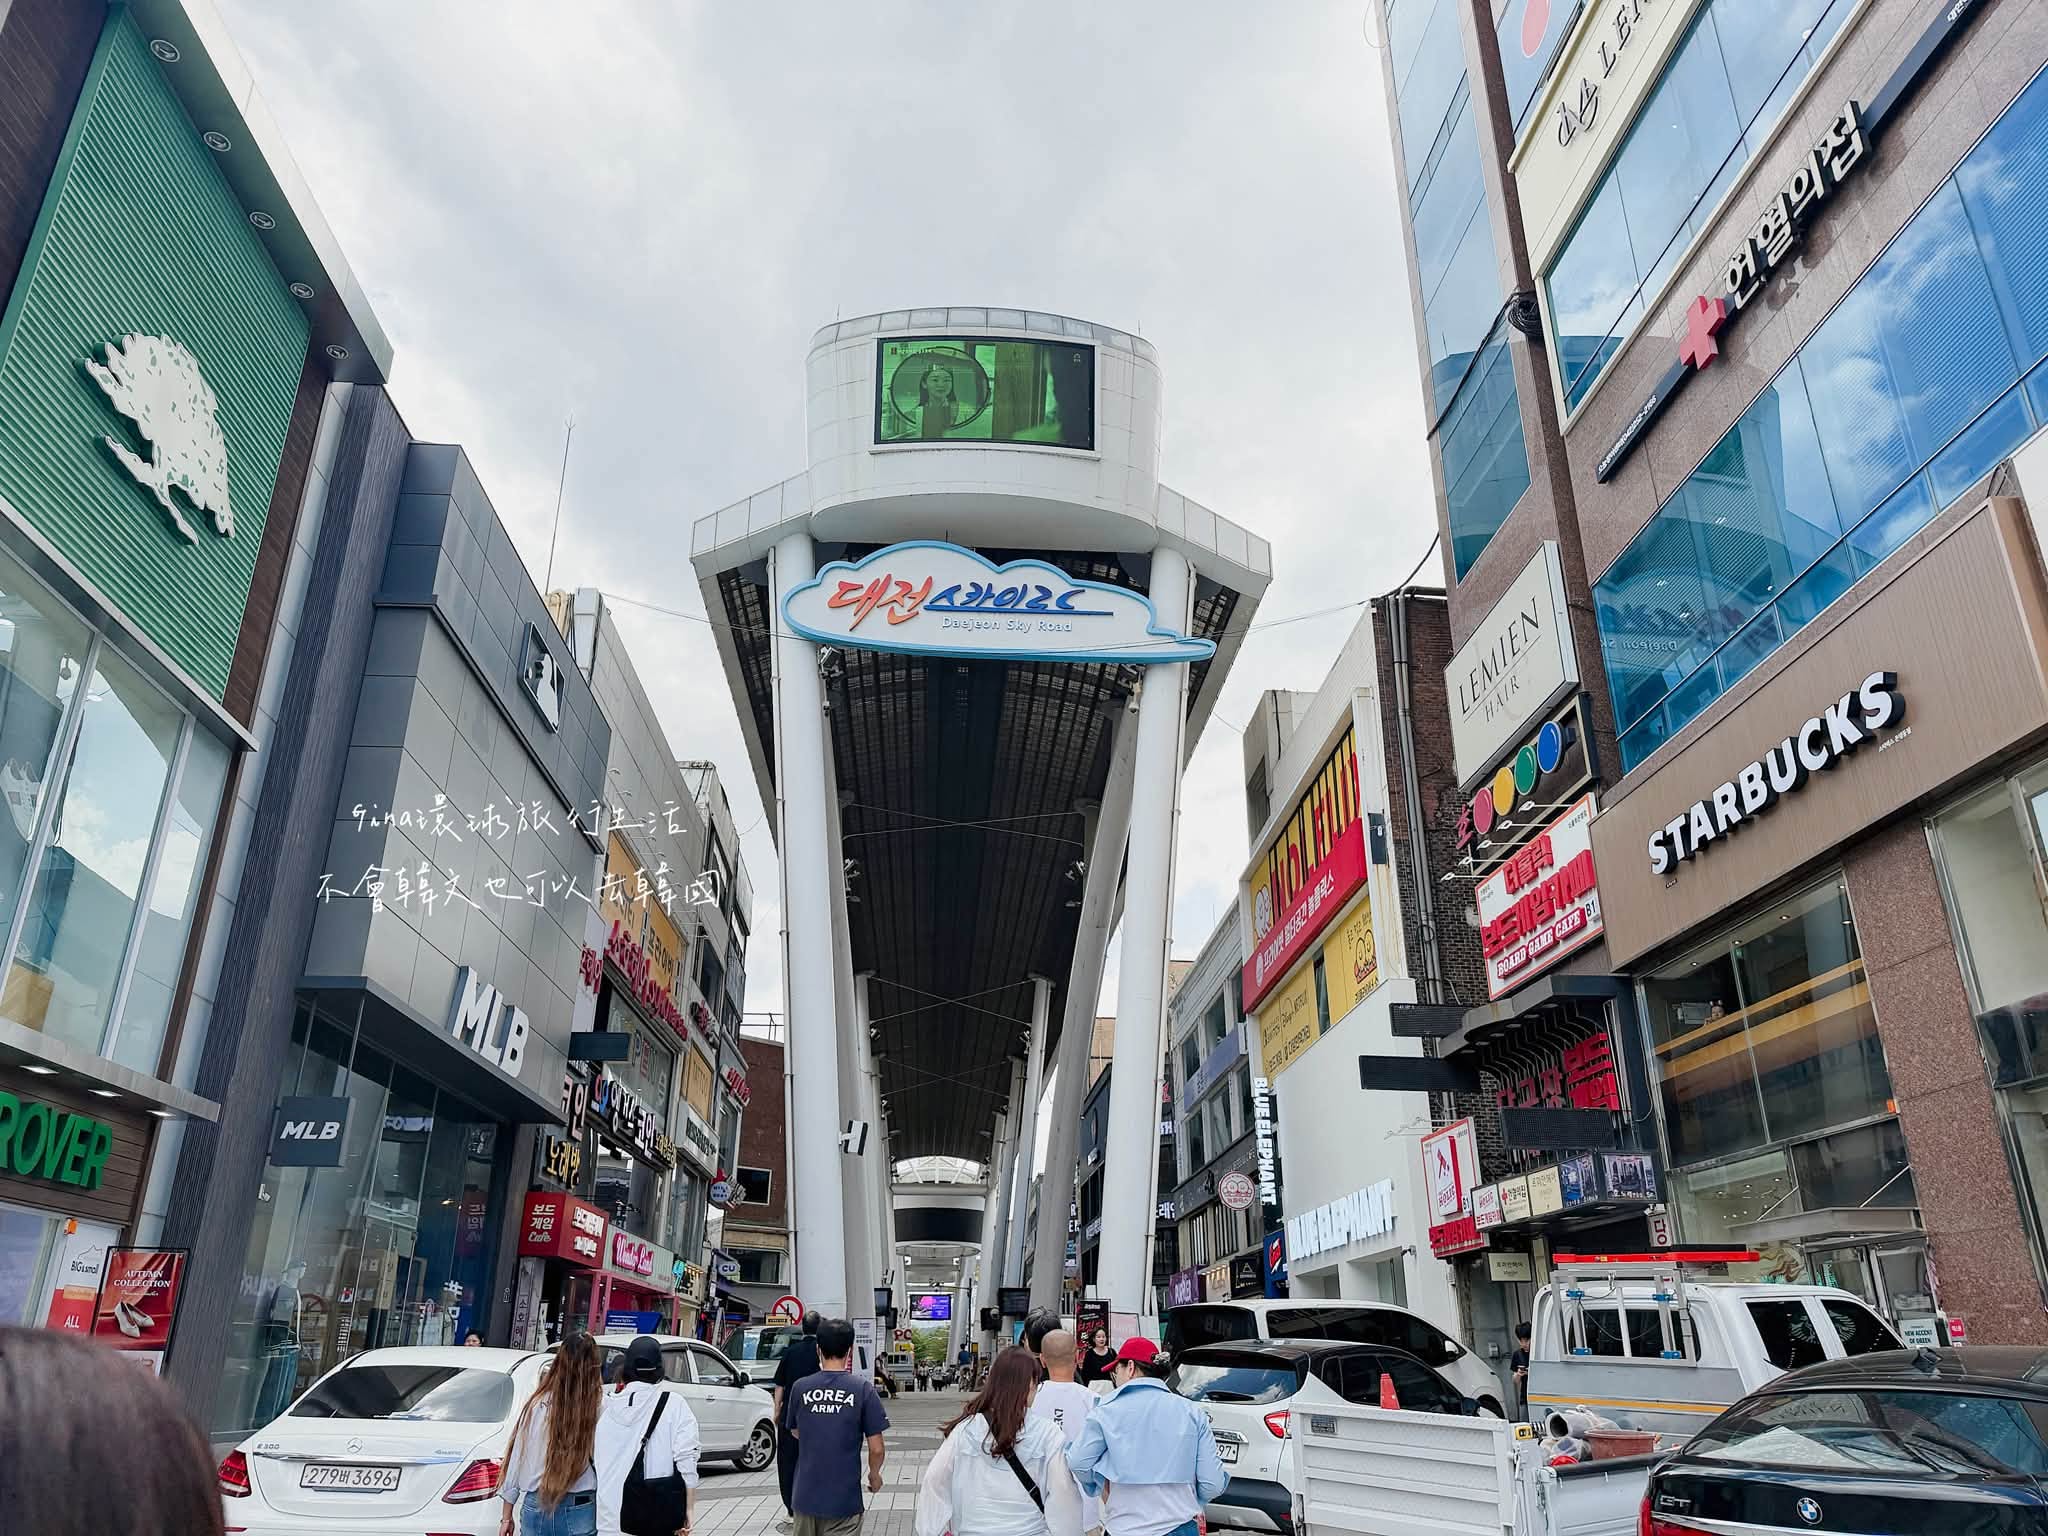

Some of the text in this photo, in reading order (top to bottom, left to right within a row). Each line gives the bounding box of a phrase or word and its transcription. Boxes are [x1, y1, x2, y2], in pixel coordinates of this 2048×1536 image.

[1722, 100, 1872, 310] 헌혈의집
[827, 573, 932, 632] 대전
[941, 615, 1073, 634] Daejeon Sky Road
[1459, 595, 1541, 715] LEMIEN
[1485, 675, 1519, 722] HAIR
[1647, 671, 1905, 876] STARBUCKS
[1503, 834, 1554, 895] 더홀릭
[1481, 850, 1597, 958] 보드게임카페
[1586, 900, 1597, 917] B1
[1496, 909, 1582, 979] BOARD GAME CAFE
[452, 965, 530, 1079] MLB
[1563, 1032, 1614, 1084] 보드
[280, 1120, 341, 1140] MLB
[1254, 1077, 1277, 1206] BLUE ELEPHANT
[531, 1204, 557, 1216] 보드
[530, 1217, 555, 1230] 게임
[1287, 1178, 1393, 1262] BLUE ELEPHANT
[125, 1270, 164, 1278] AUTUMN
[721, 1264, 736, 1273] CU
[113, 1279, 172, 1288] COLLECTION
[64, 1314, 80, 1329] ALL
[894, 1329, 912, 1341] PC
[802, 1389, 856, 1407] KOREA
[811, 1403, 843, 1414] ARMY
[1215, 1444, 1232, 1457] 97
[352, 1470, 393, 1487] 3696
[1660, 1494, 1692, 1508] GT
